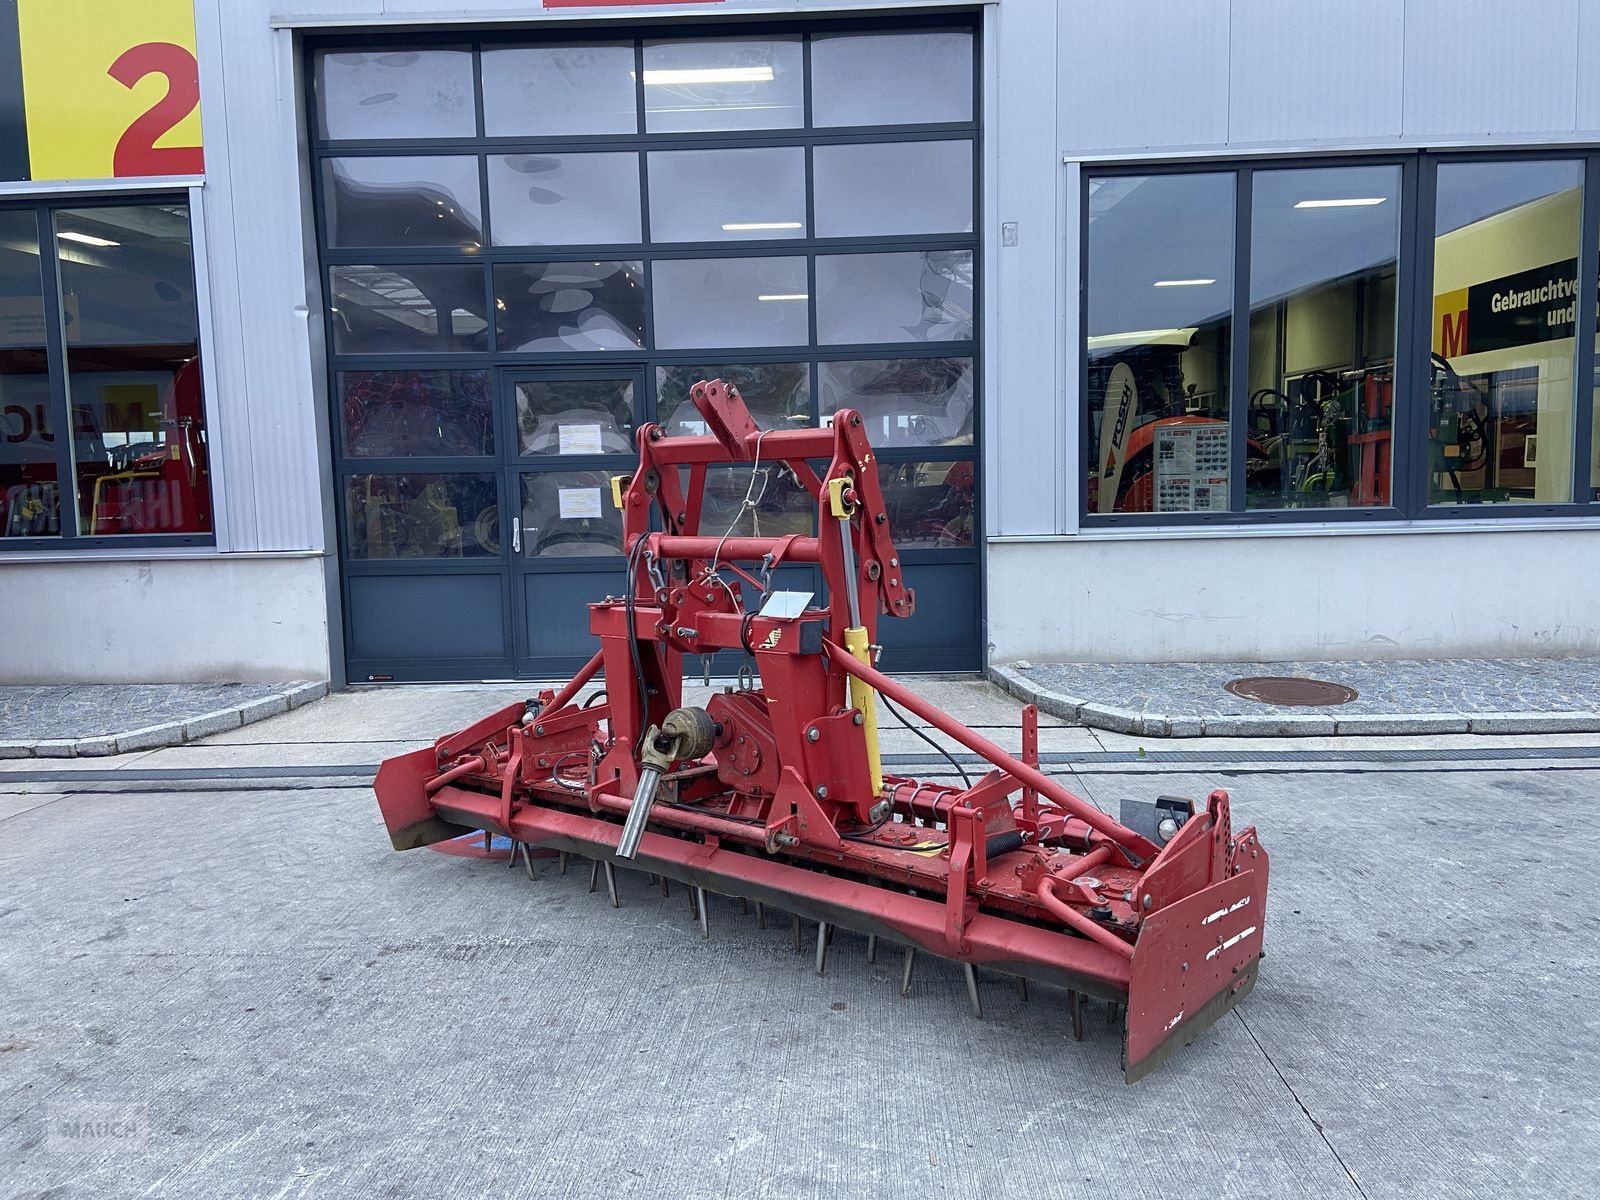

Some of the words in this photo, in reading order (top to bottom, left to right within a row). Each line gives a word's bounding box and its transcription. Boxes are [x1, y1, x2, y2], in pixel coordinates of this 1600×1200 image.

[107, 42, 205, 177] 2
[1547, 301, 1577, 326] und
[1112, 384, 1132, 449] POSCH
